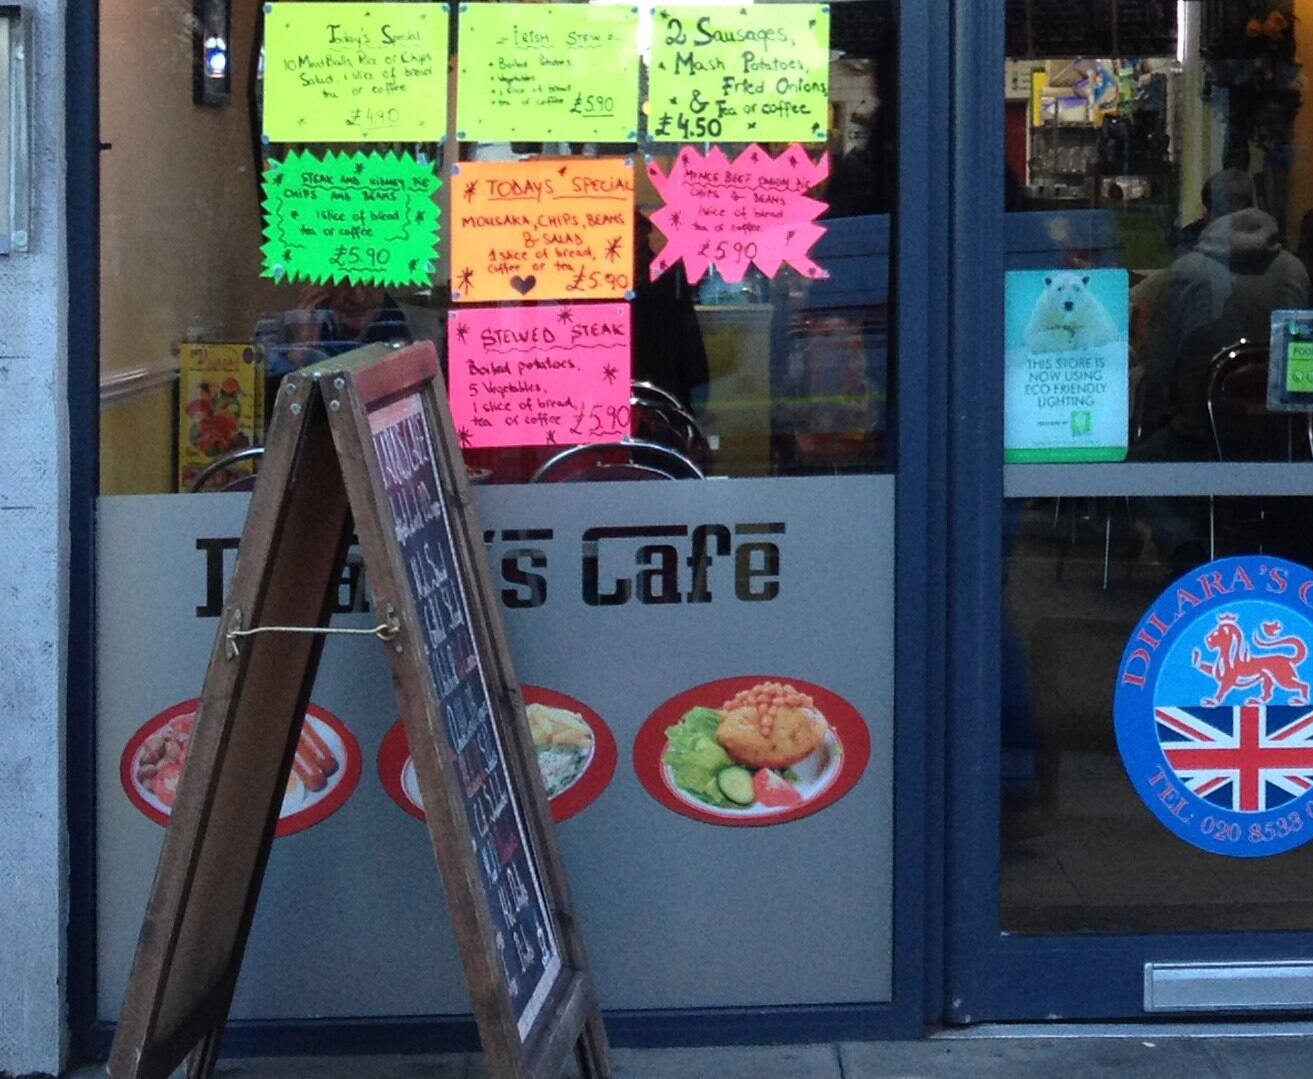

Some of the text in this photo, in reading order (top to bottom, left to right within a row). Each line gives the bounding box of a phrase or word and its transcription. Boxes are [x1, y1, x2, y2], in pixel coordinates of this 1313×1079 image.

[666, 18, 687, 46] 2
[674, 51, 725, 76] Mash
[722, 76, 764, 96] Fried
[689, 89, 709, 114] &
[743, 103, 758, 115] or
[762, 101, 811, 118] coffee
[655, 113, 722, 139] £4.50
[572, 176, 634, 194] SPECIAL
[543, 233, 583, 245] SALAD
[532, 263, 545, 272] or
[481, 323, 625, 347] STEWED STEAK
[1026, 357, 1105, 369] THIS STORE IS
[1029, 370, 1103, 382] NOW USING
[469, 383, 478, 396] 5
[1025, 383, 1106, 395] ECO FRIENDLY
[519, 397, 532, 410] of
[1038, 396, 1095, 407] LIGHTING
[505, 415, 518, 427] or
[524, 412, 562, 427] coffee
[1122, 564, 1288, 689] DILARA'S
[1200, 816, 1242, 842] 020
[1248, 811, 1304, 843] 8533
